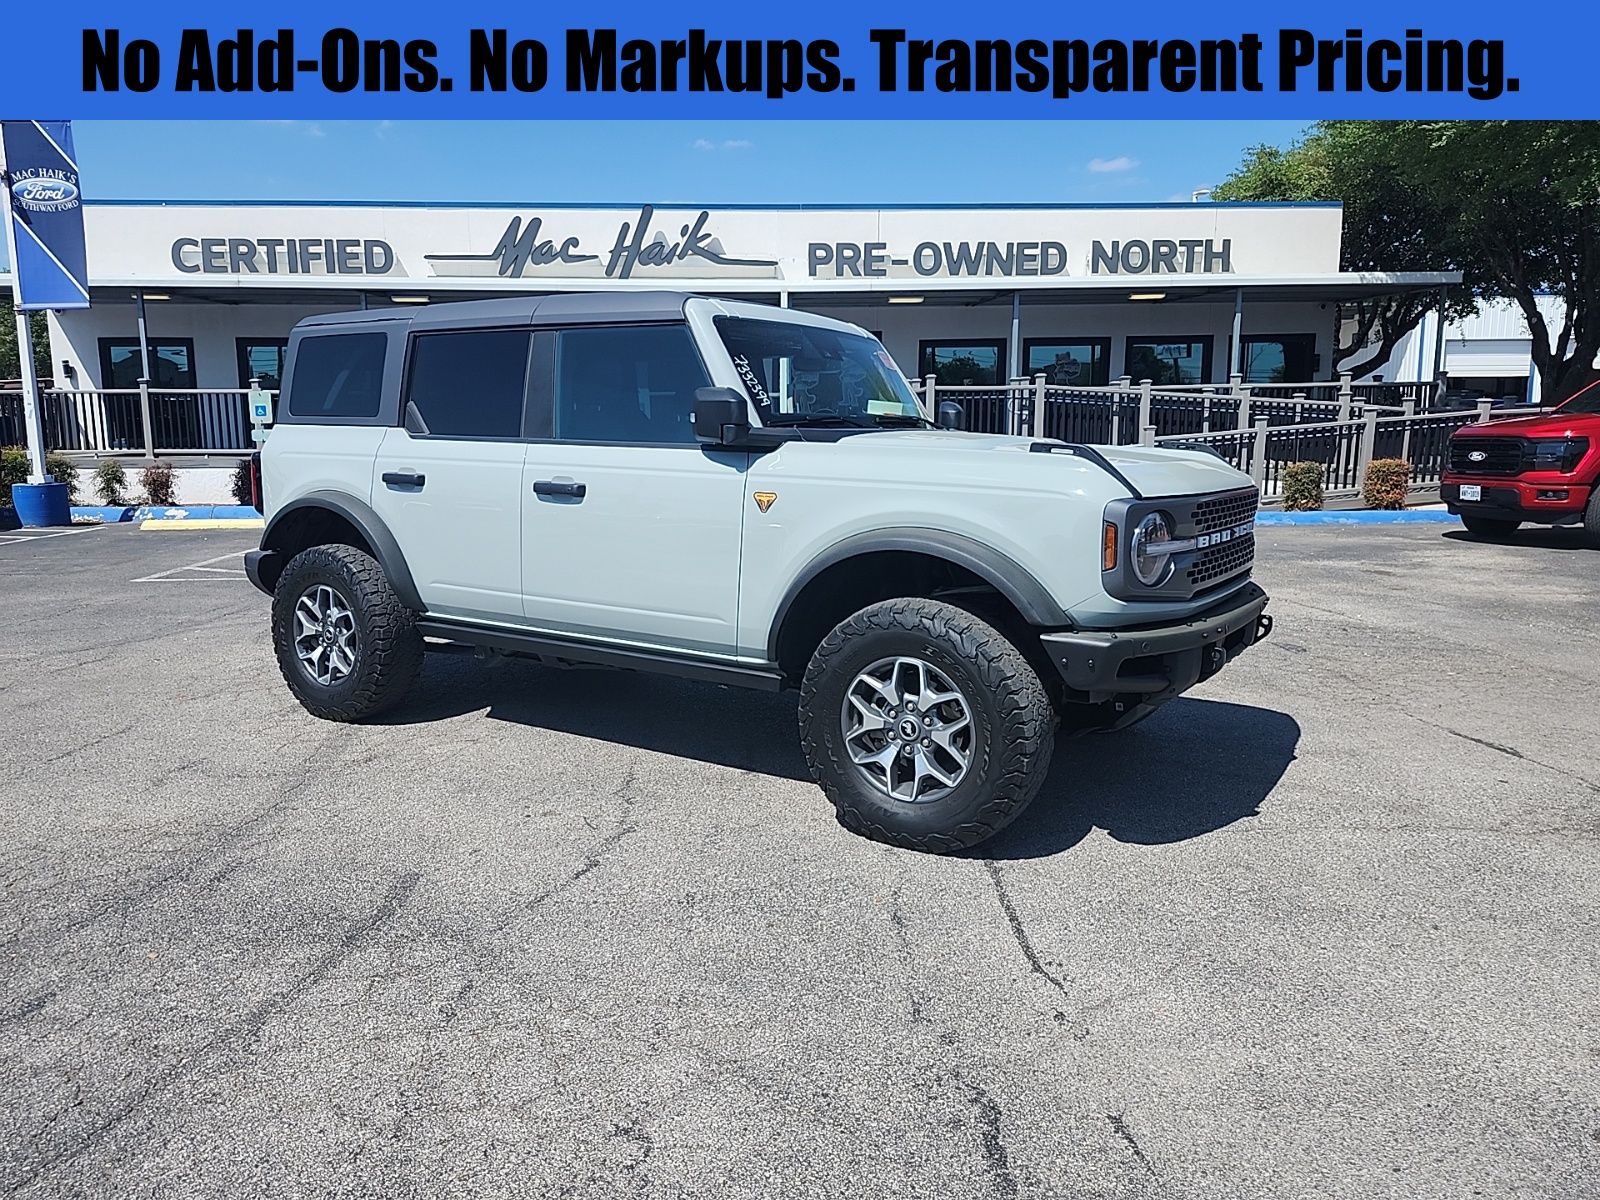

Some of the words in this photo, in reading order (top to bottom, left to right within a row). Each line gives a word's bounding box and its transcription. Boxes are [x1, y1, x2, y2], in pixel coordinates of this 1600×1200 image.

[11, 169, 35, 182] MAC
[38, 168, 77, 184] HAIK'S
[24, 182, 65, 199] Ford
[58, 199, 78, 212] FORD
[424, 216, 599, 278] Mac
[604, 204, 778, 279] Haik
[171, 238, 393, 275] CERTIFIED
[808, 240, 1067, 277] PRE-OWNED
[1091, 238, 1232, 274] NORTH
